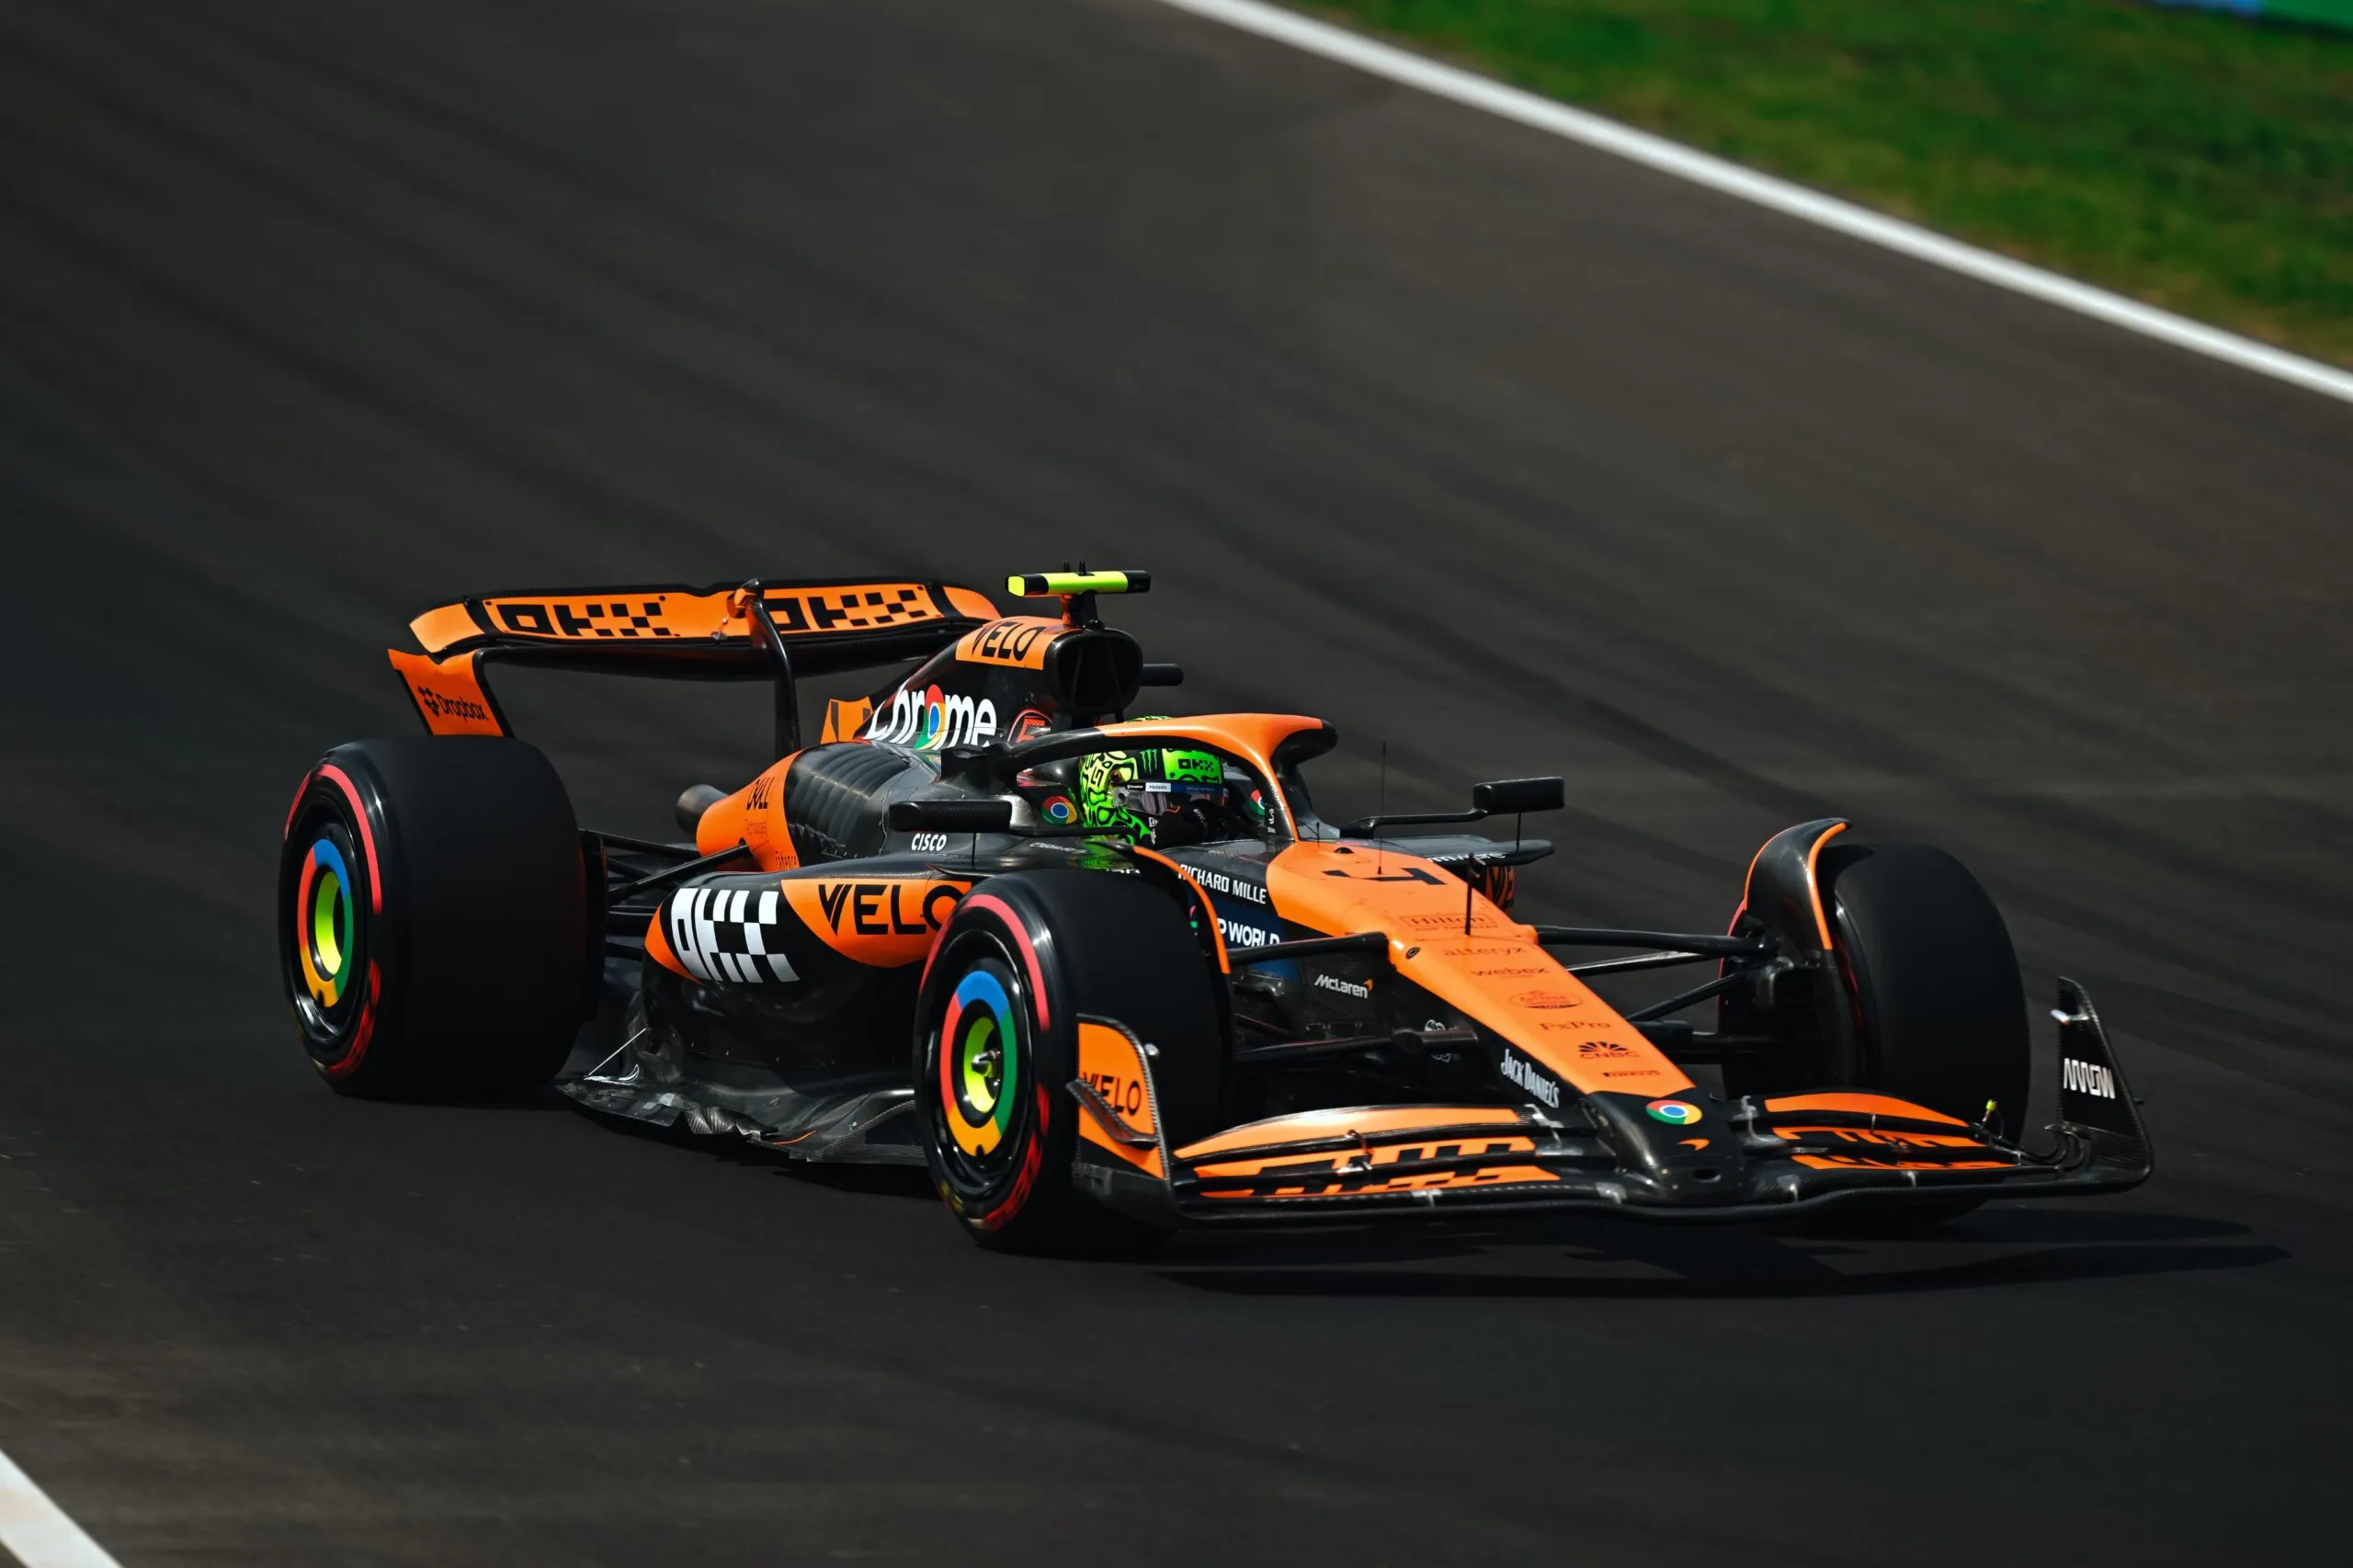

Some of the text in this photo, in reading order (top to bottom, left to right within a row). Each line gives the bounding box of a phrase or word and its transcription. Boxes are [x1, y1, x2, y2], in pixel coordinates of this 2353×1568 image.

[972, 621, 1046, 662] VELO
[436, 694, 489, 722] Dropbox
[1233, 880, 1267, 904] MILLE
[818, 883, 965, 936] VELO
[1314, 973, 1368, 999] McLaren
